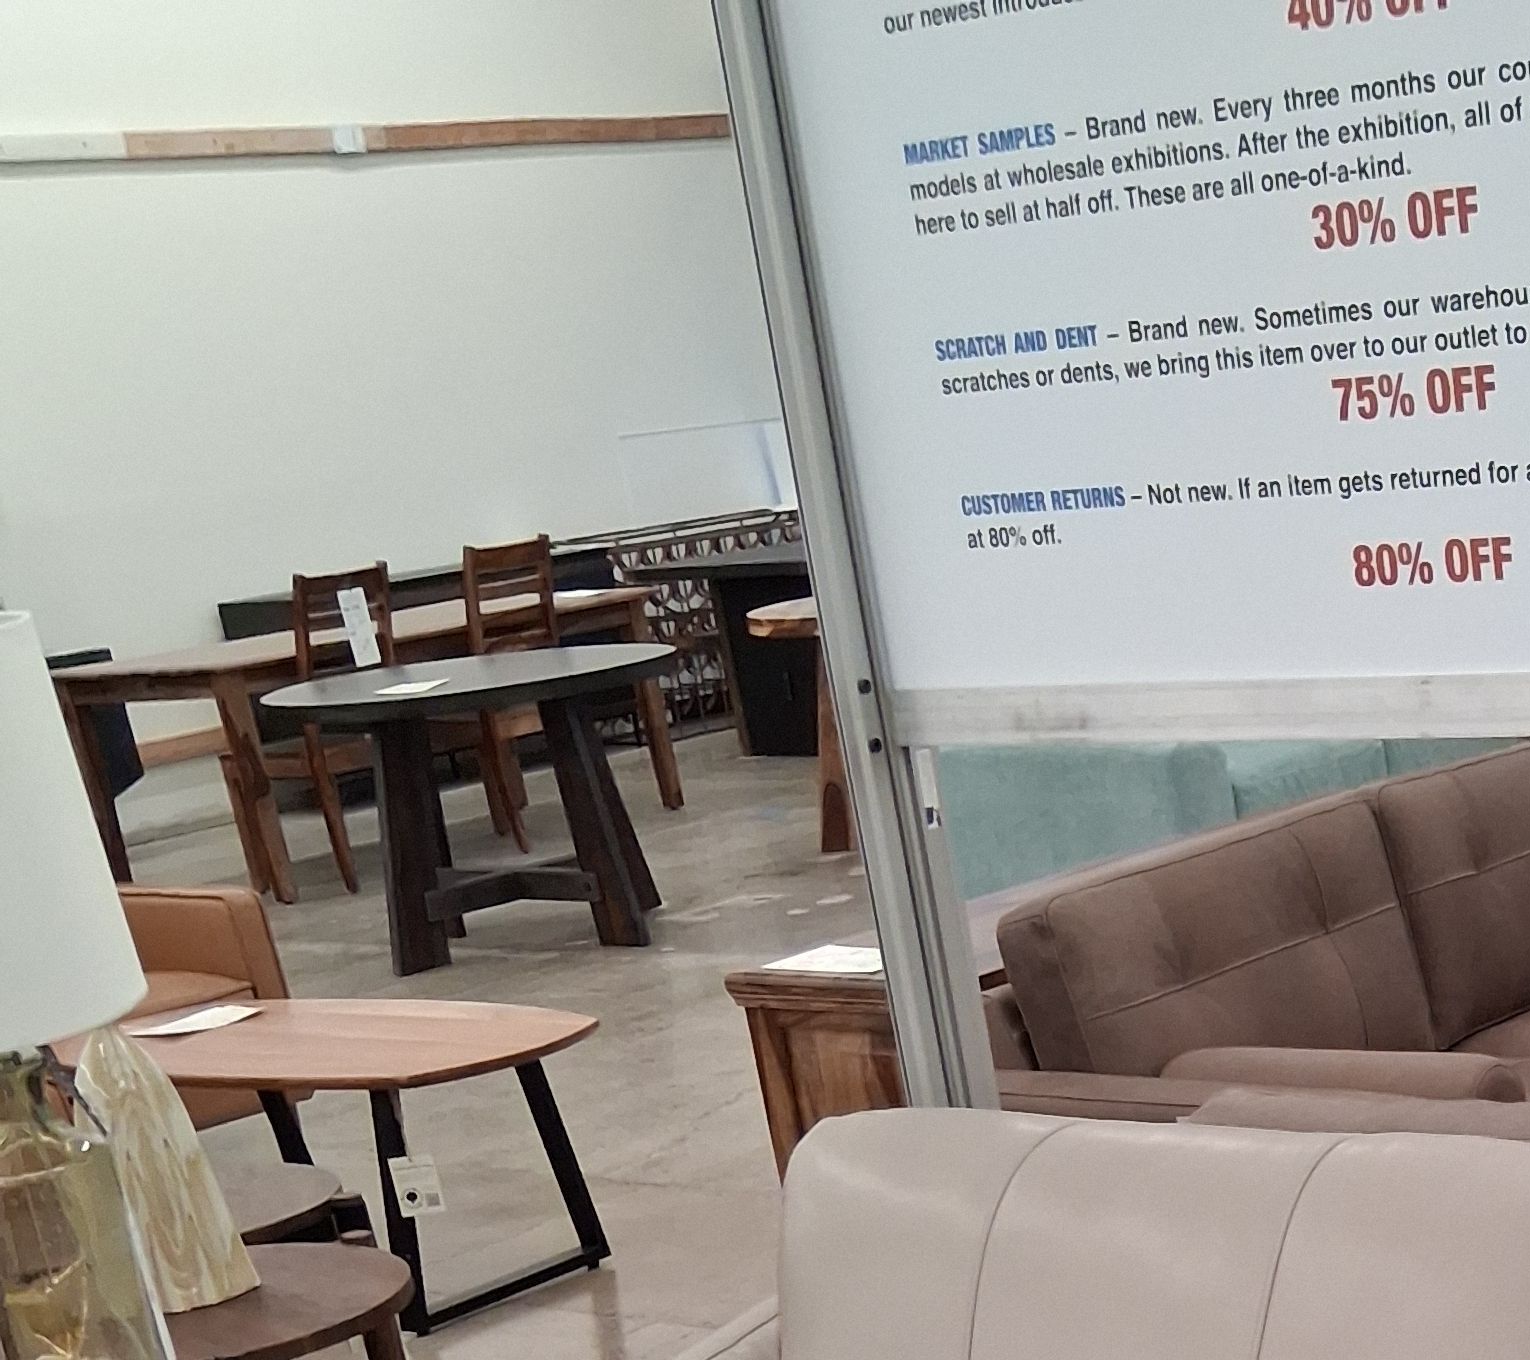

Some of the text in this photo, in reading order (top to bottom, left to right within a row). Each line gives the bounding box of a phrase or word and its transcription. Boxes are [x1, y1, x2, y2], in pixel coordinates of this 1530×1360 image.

[884, 12, 914, 34] our
[903, 135, 968, 165] MARKET
[978, 123, 1056, 155] SAMPLES
[1086, 109, 1146, 140] Brand
[1156, 107, 1203, 130] new.
[1213, 97, 1272, 122] Every
[1284, 87, 1339, 112] three
[1351, 71, 1435, 103] months
[1448, 66, 1485, 89] our
[910, 172, 977, 201] models
[984, 168, 1002, 191] at
[1007, 154, 1104, 187] wholesale
[1112, 142, 1230, 174] exhibitions.
[1238, 131, 1287, 157] After
[1296, 124, 1329, 149] the
[1338, 109, 1455, 144] exhibition,
[1465, 100, 1490, 128] all
[1500, 96, 1522, 123] of
[915, 151, 1411, 235] here to sell at half off. These are all one-of-a-kind.
[1312, 186, 1478, 249] 30% OFF
[935, 334, 1007, 361] SCRATCH
[1015, 330, 1047, 354] AND
[1055, 324, 1097, 350] DENT
[1128, 315, 1188, 342] Brand
[1198, 316, 1244, 336] new.
[1255, 301, 1372, 330] Sometimes
[1384, 297, 1419, 318] our
[942, 369, 1030, 395] scratches
[1036, 369, 1054, 386] or
[1061, 361, 1119, 384] dents,
[1124, 361, 1152, 378] we
[1157, 352, 1209, 378] bring
[1216, 346, 1253, 370] this
[1259, 344, 1304, 367] item
[1311, 341, 1357, 362] over
[1363, 336, 1384, 357] to
[1392, 335, 1427, 355] our
[1435, 324, 1499, 351] outlet
[1505, 322, 1527, 344] to
[1331, 365, 1495, 421] 75% OFF
[961, 491, 1047, 516] CUSTOMER
[1050, 486, 1125, 511] RETURNS
[1147, 483, 1182, 505] Not
[1187, 484, 1233, 503] new.
[1238, 477, 1250, 499] If
[1258, 481, 1281, 498] an
[1287, 474, 1332, 496] item
[1339, 471, 1383, 499] gets
[1390, 462, 1481, 490] returned
[1488, 461, 1518, 484] for
[968, 524, 1061, 548] at 80% off.
[1353, 537, 1512, 586] 80% OFF
